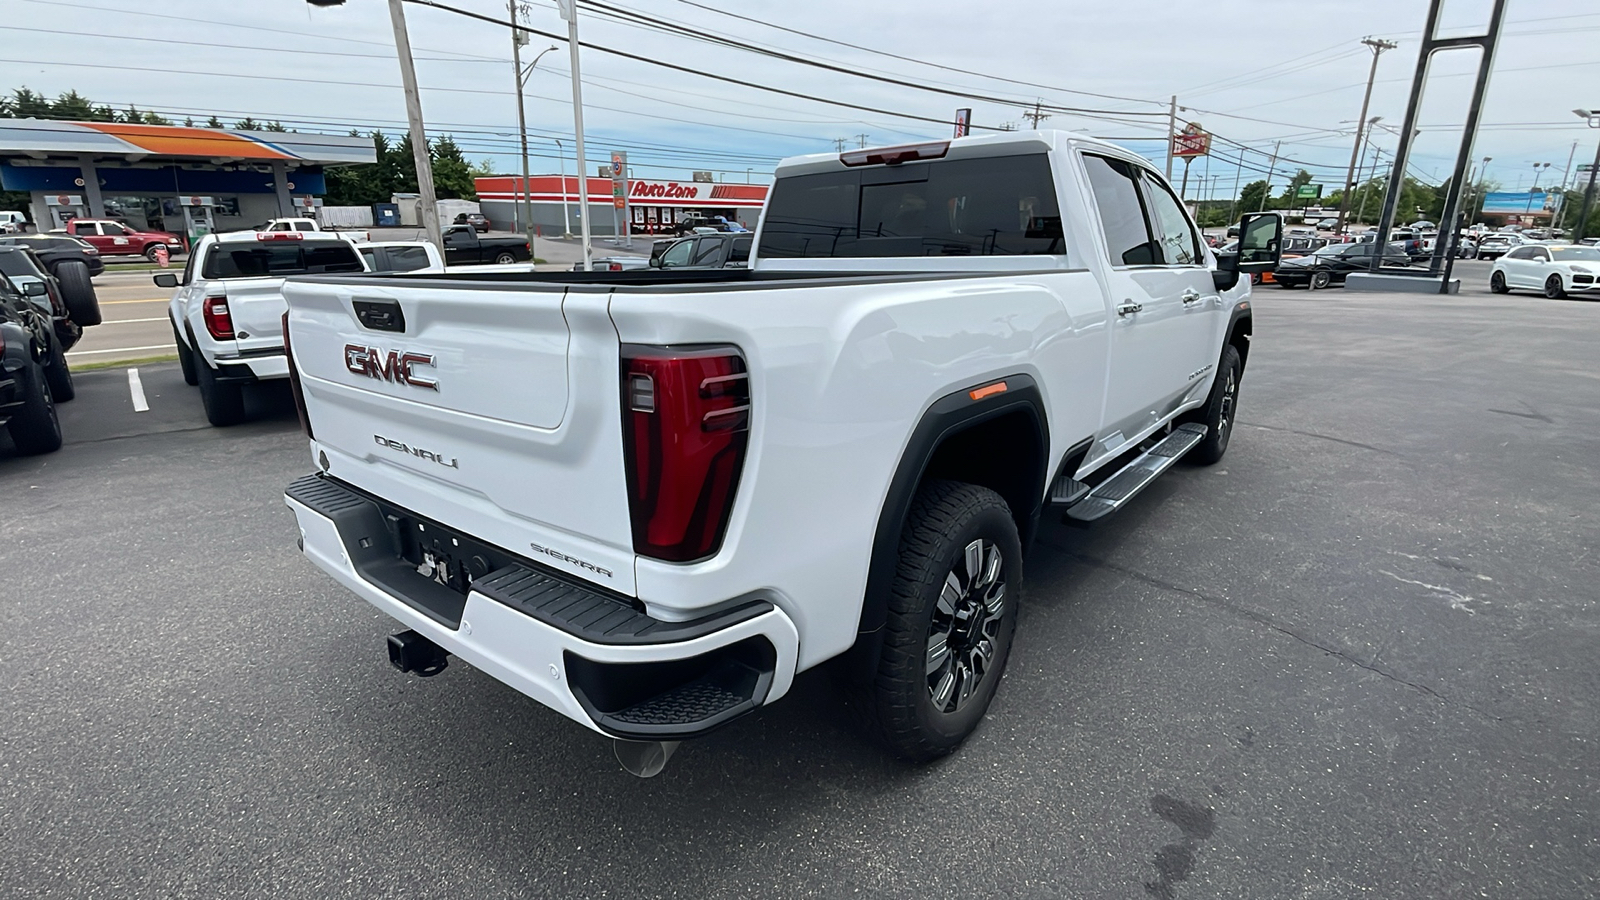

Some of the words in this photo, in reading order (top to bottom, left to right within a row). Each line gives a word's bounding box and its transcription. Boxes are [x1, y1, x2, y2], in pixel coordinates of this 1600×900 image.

[344, 342, 439, 392] GMC
[373, 433, 459, 470] DENALI
[530, 542, 613, 578] SIERRA
